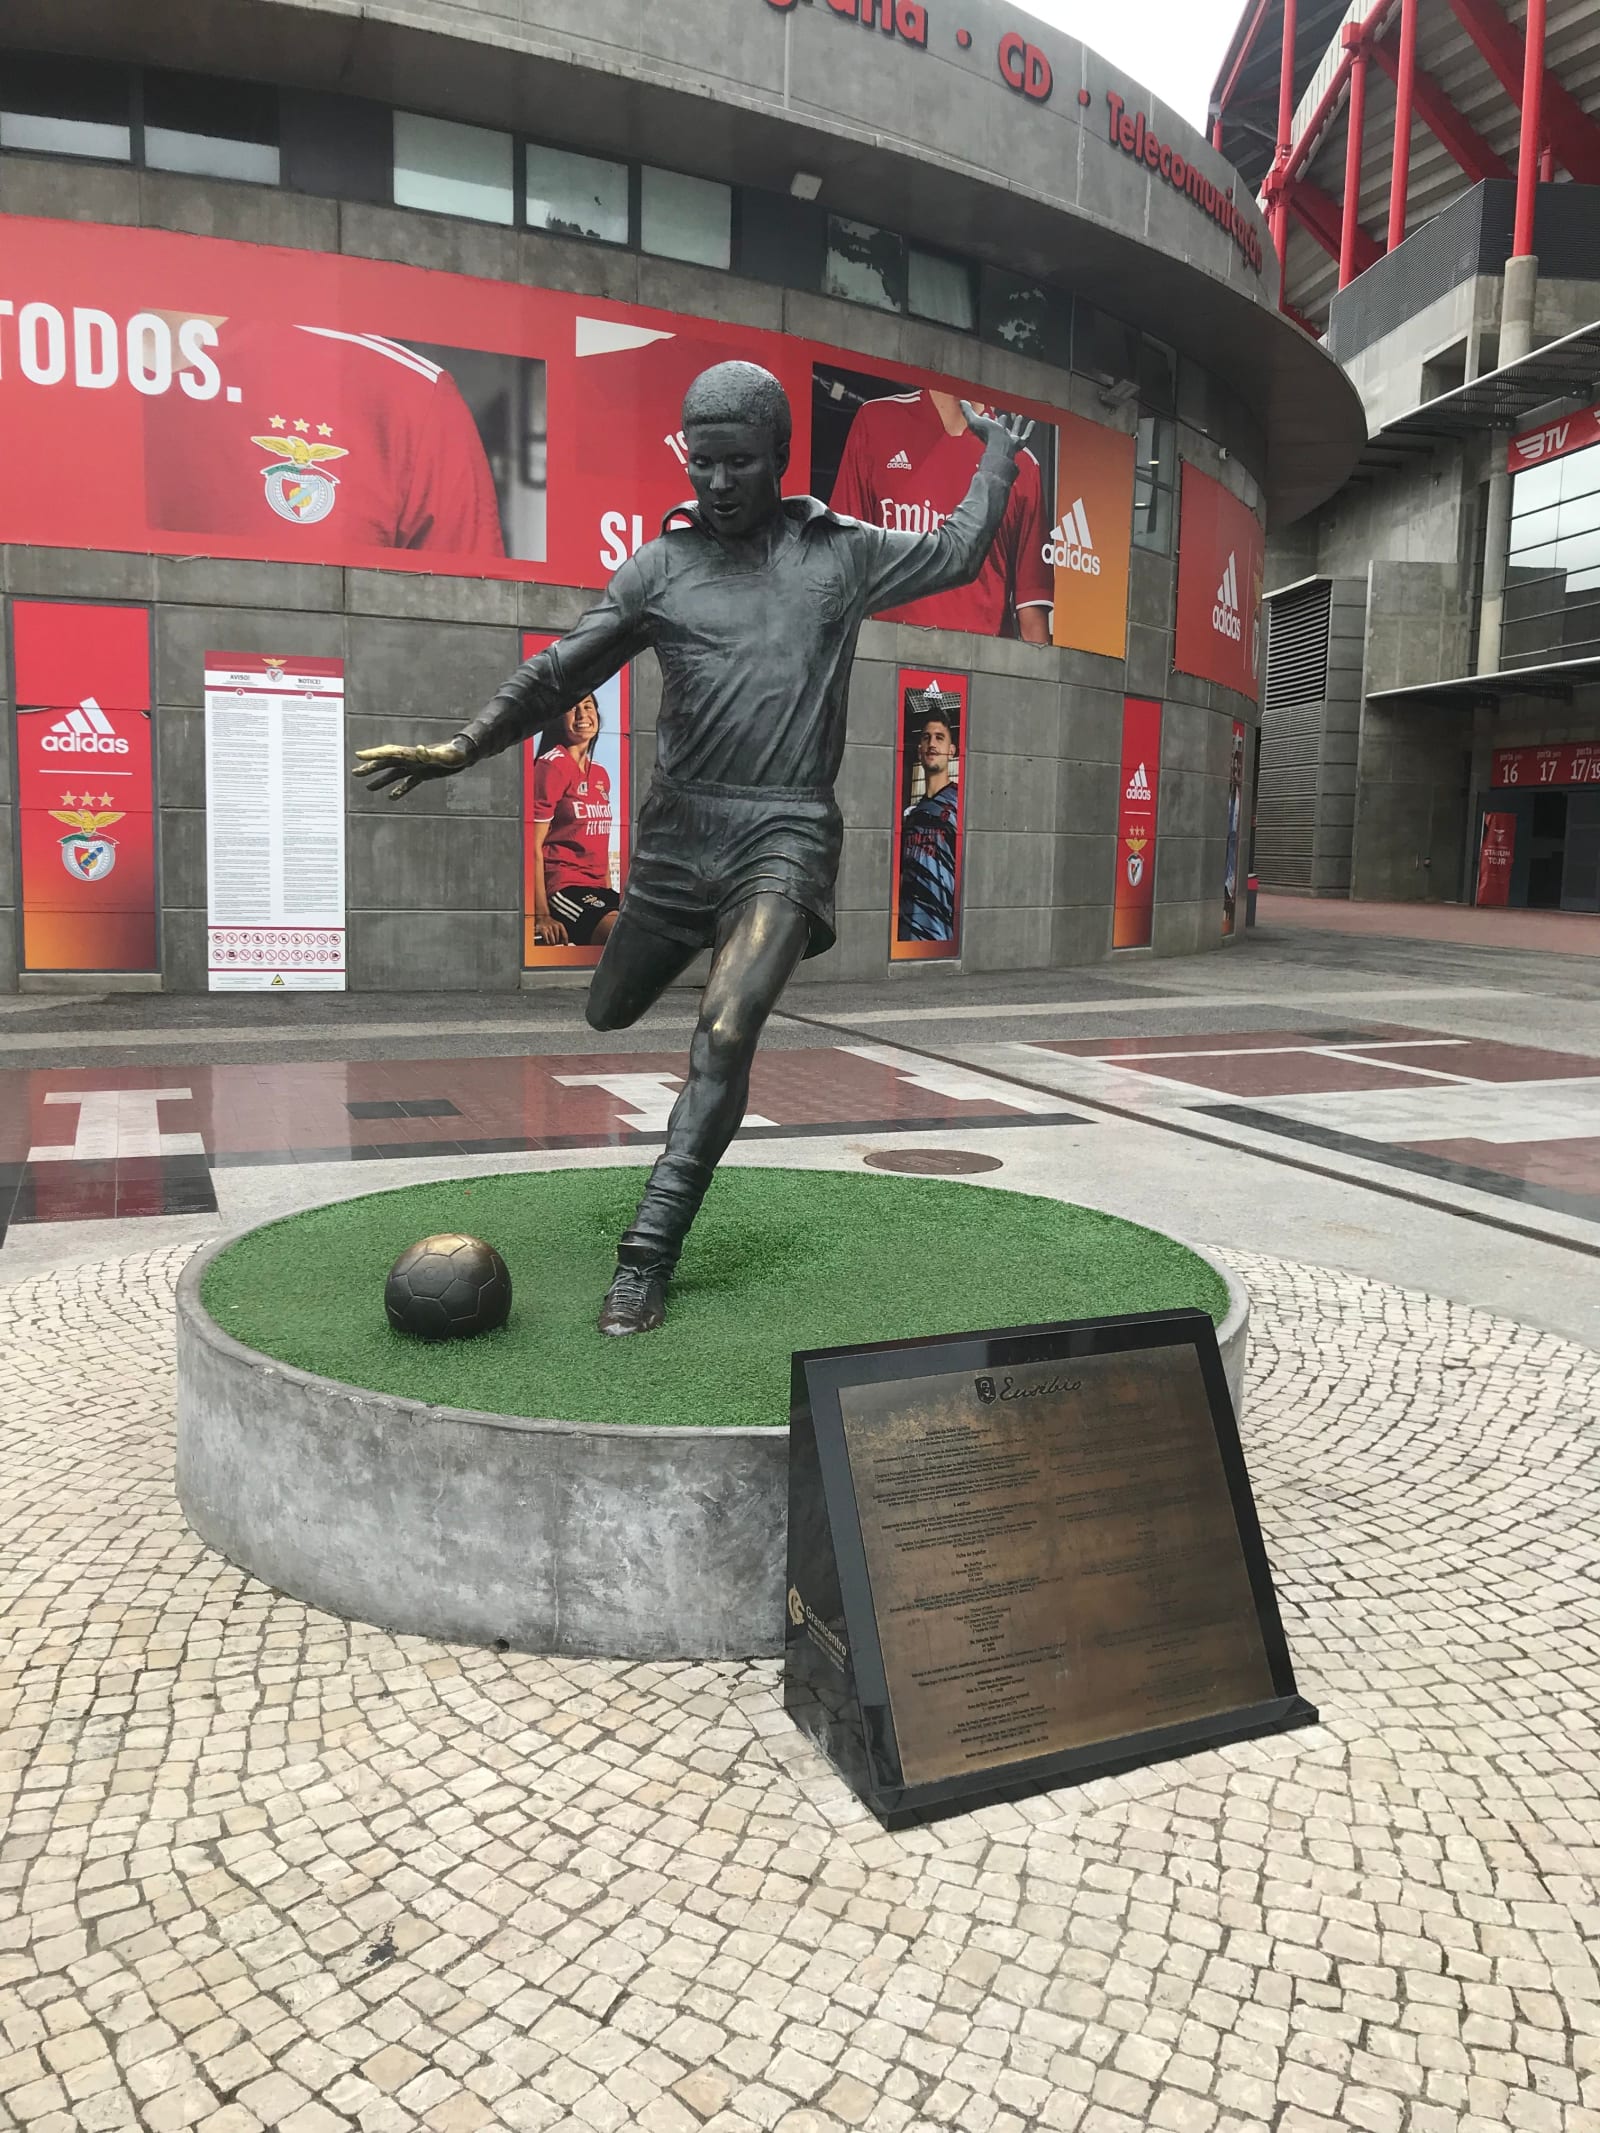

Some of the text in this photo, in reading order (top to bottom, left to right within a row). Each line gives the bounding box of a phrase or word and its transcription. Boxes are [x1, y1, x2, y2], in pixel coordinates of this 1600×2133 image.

[999, 32, 1052, 100] CD
[887, 462, 912, 470] adidas
[880, 498, 953, 531] Emir
[1042, 541, 1101, 576] adidas
[1212, 602, 1241, 642] adidas
[41, 731, 129, 754] adidas
[1503, 763, 1518, 783] 16
[1540, 761, 1557, 782] 17
[1126, 786, 1151, 801] adidas
